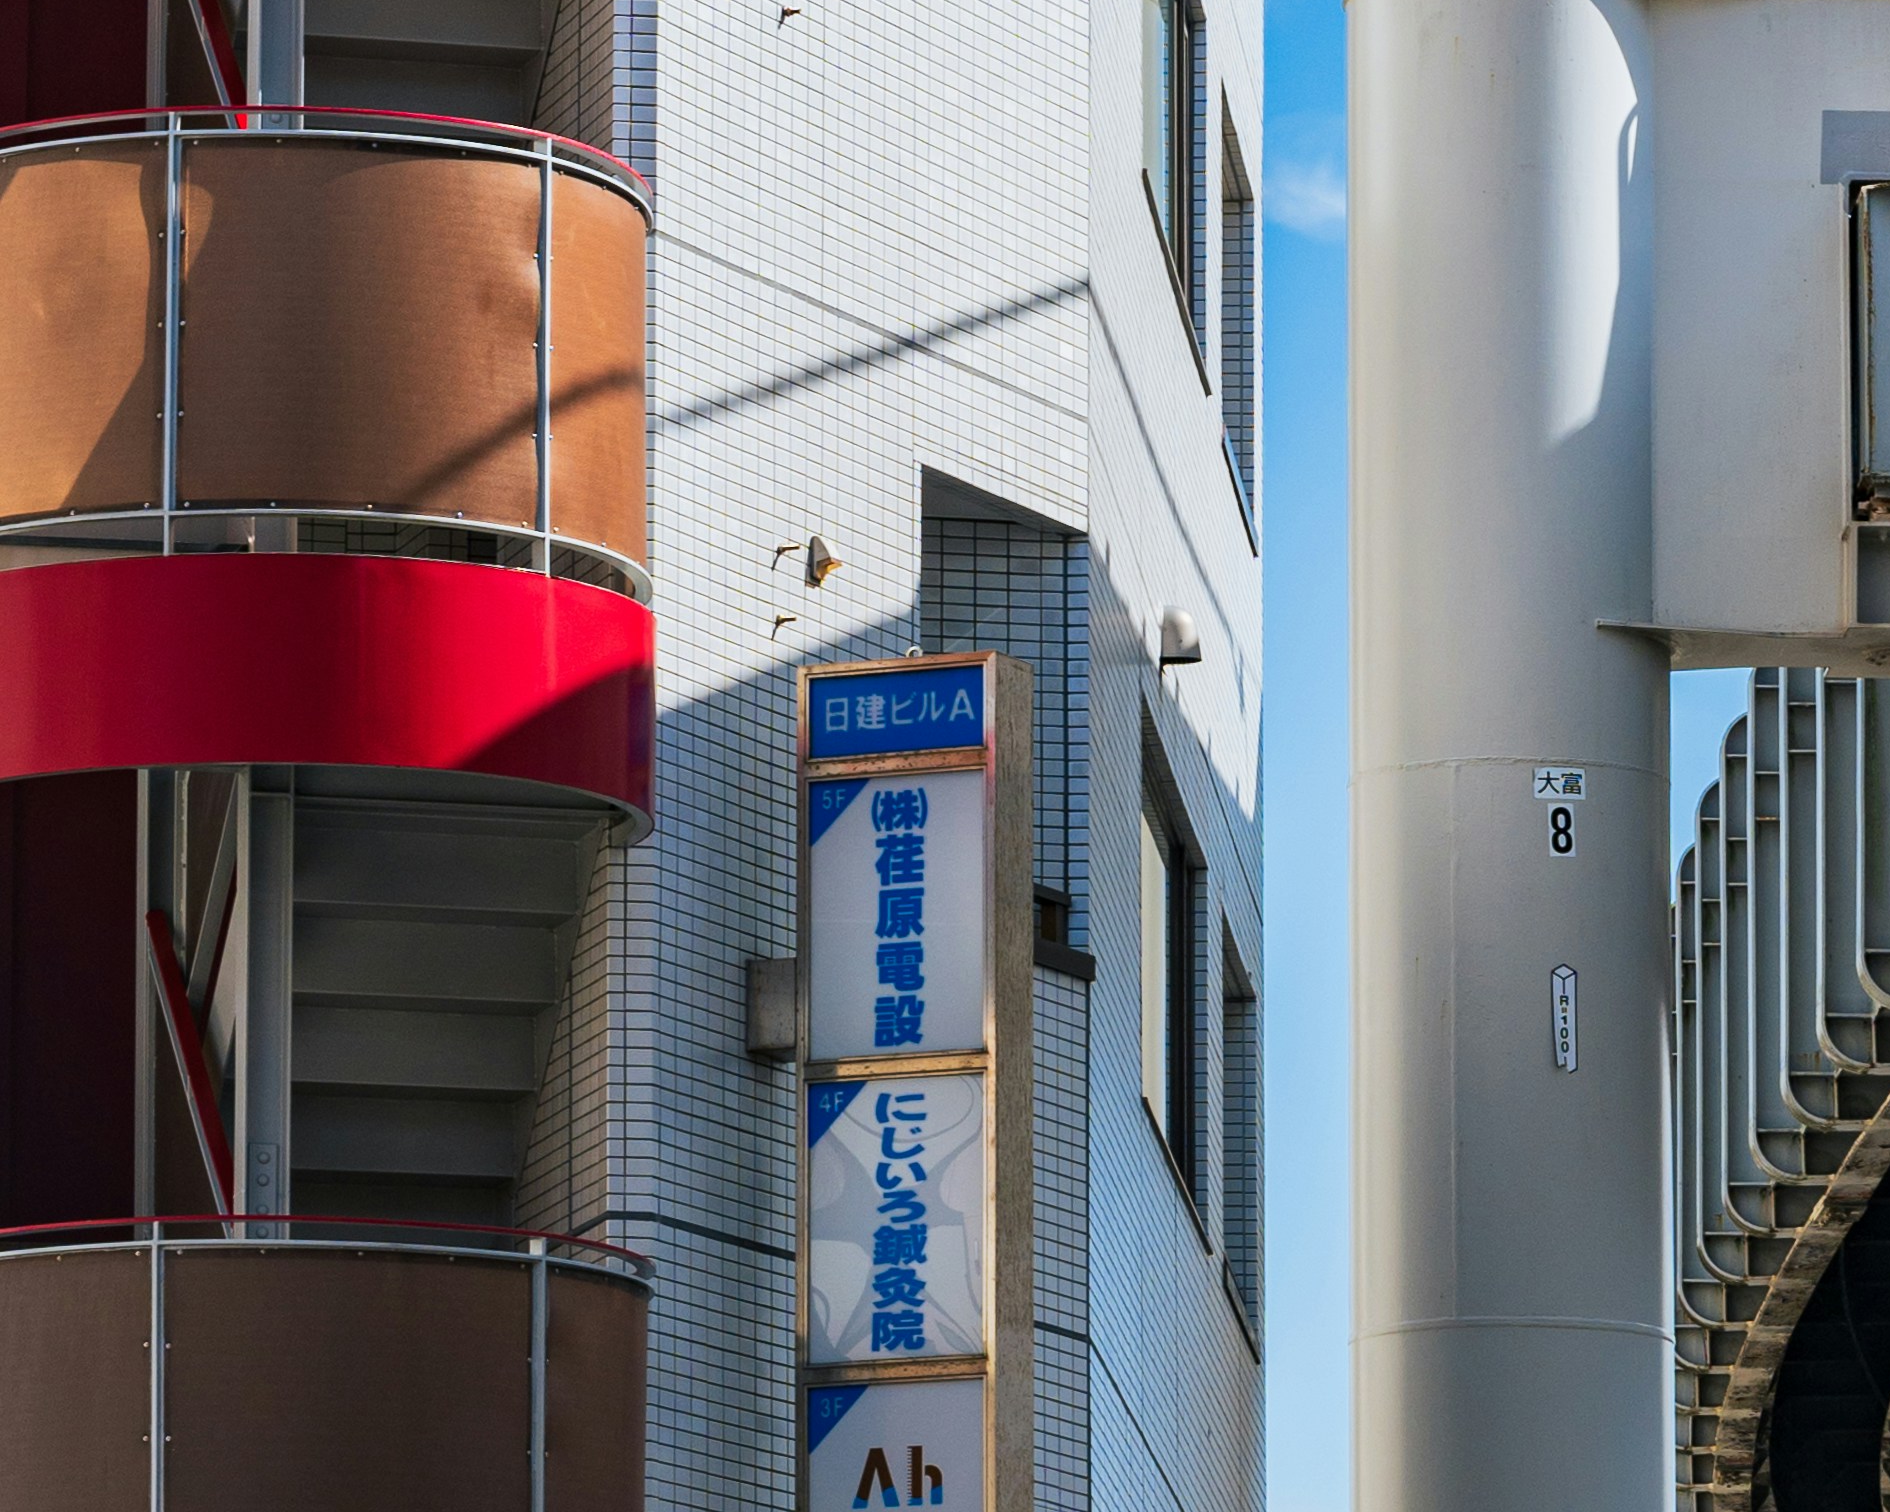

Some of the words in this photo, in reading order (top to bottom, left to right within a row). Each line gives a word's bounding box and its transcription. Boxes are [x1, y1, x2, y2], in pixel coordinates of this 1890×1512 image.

[823, 687, 976, 733] 日建ビルA
[1537, 771, 1583, 796] 大富
[822, 789, 846, 810] 5F
[1550, 807, 1573, 854] 8
[819, 1091, 845, 1114] 4F
[871, 1091, 929, 1353] にじいろ鍼灸院
[820, 1397, 844, 1419] 3F
